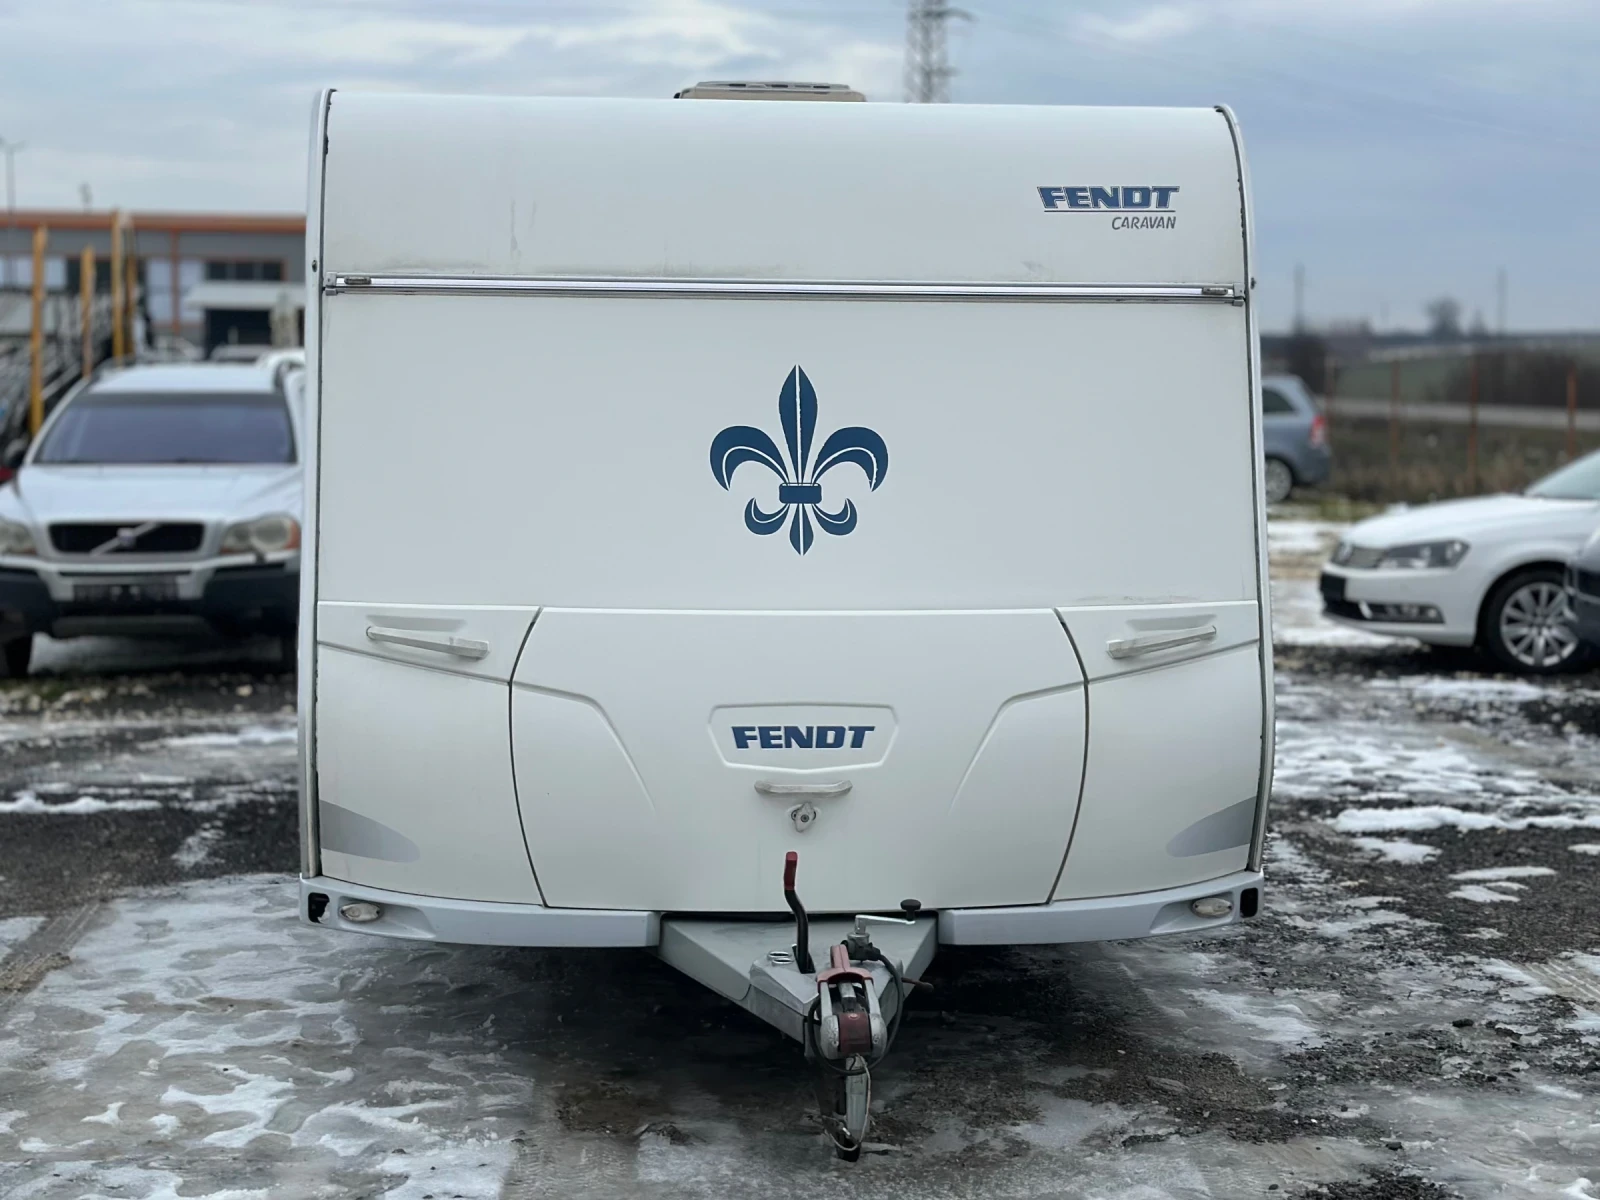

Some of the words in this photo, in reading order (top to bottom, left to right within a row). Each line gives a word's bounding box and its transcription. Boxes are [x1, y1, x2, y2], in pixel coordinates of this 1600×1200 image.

[1037, 186, 1180, 209] FENDT
[1111, 216, 1177, 230] CARAVAN
[731, 726, 875, 749] FENDT
